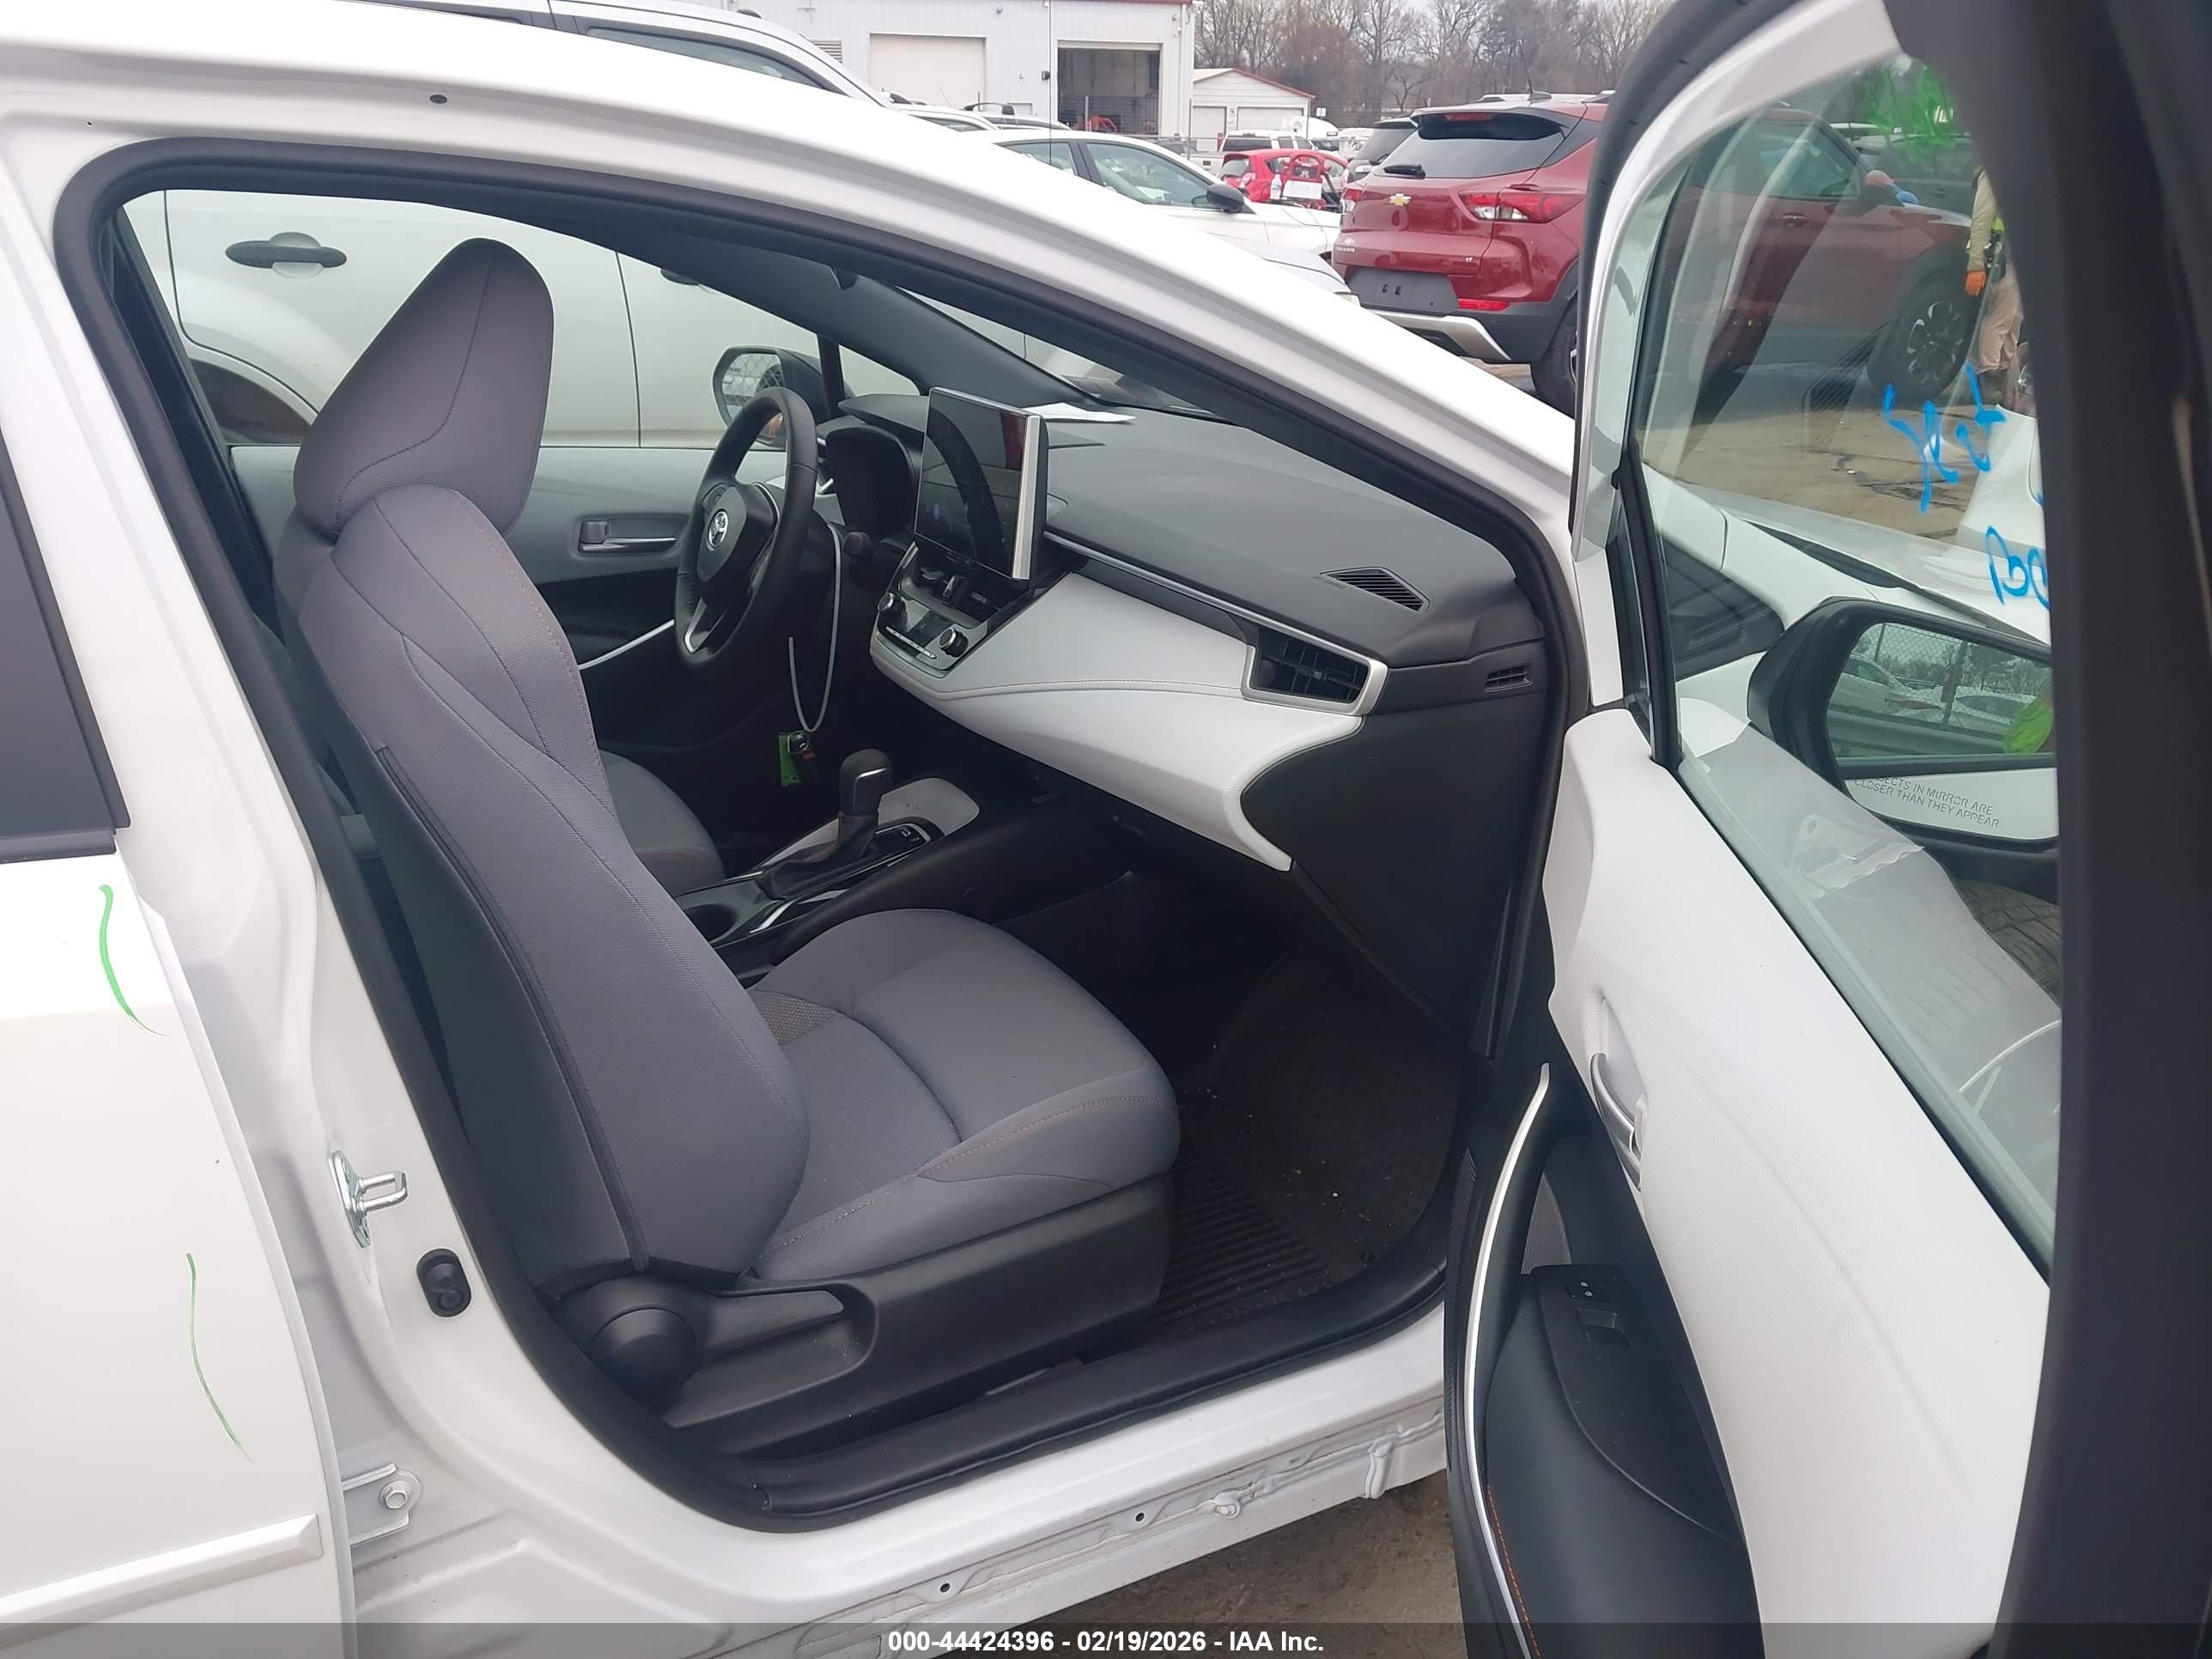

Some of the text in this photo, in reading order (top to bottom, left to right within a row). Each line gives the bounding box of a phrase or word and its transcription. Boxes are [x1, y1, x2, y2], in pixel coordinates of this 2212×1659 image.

[1855, 778, 2000, 829] CLOSER THAN THEY APPEAR
[1913, 783, 1925, 794] IN
[1926, 787, 1969, 808] MIRROR
[1971, 802, 1994, 816] ARE
